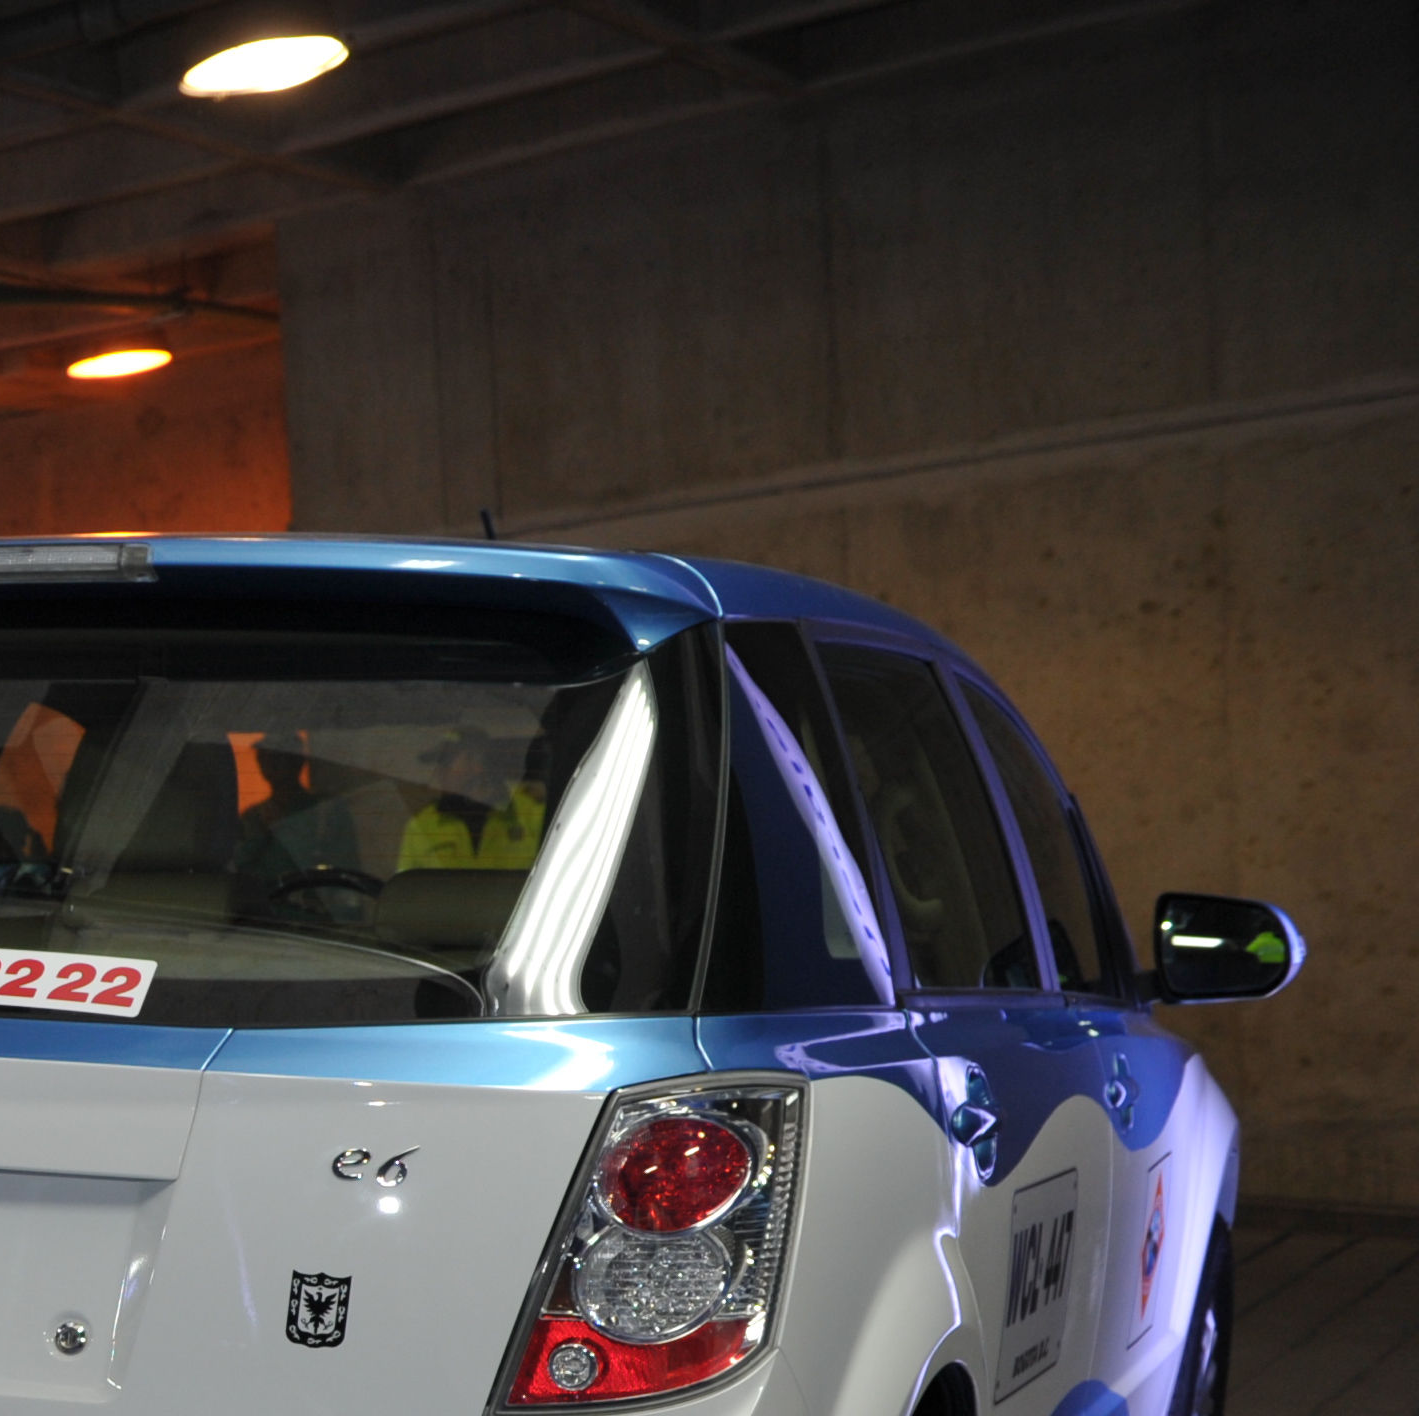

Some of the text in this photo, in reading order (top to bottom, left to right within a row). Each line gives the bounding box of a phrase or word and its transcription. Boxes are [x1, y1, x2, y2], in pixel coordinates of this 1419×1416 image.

[331, 1145, 420, 1187] e6
[1006, 1222, 1043, 1328] WCL
[1043, 1211, 1074, 1306] 447
